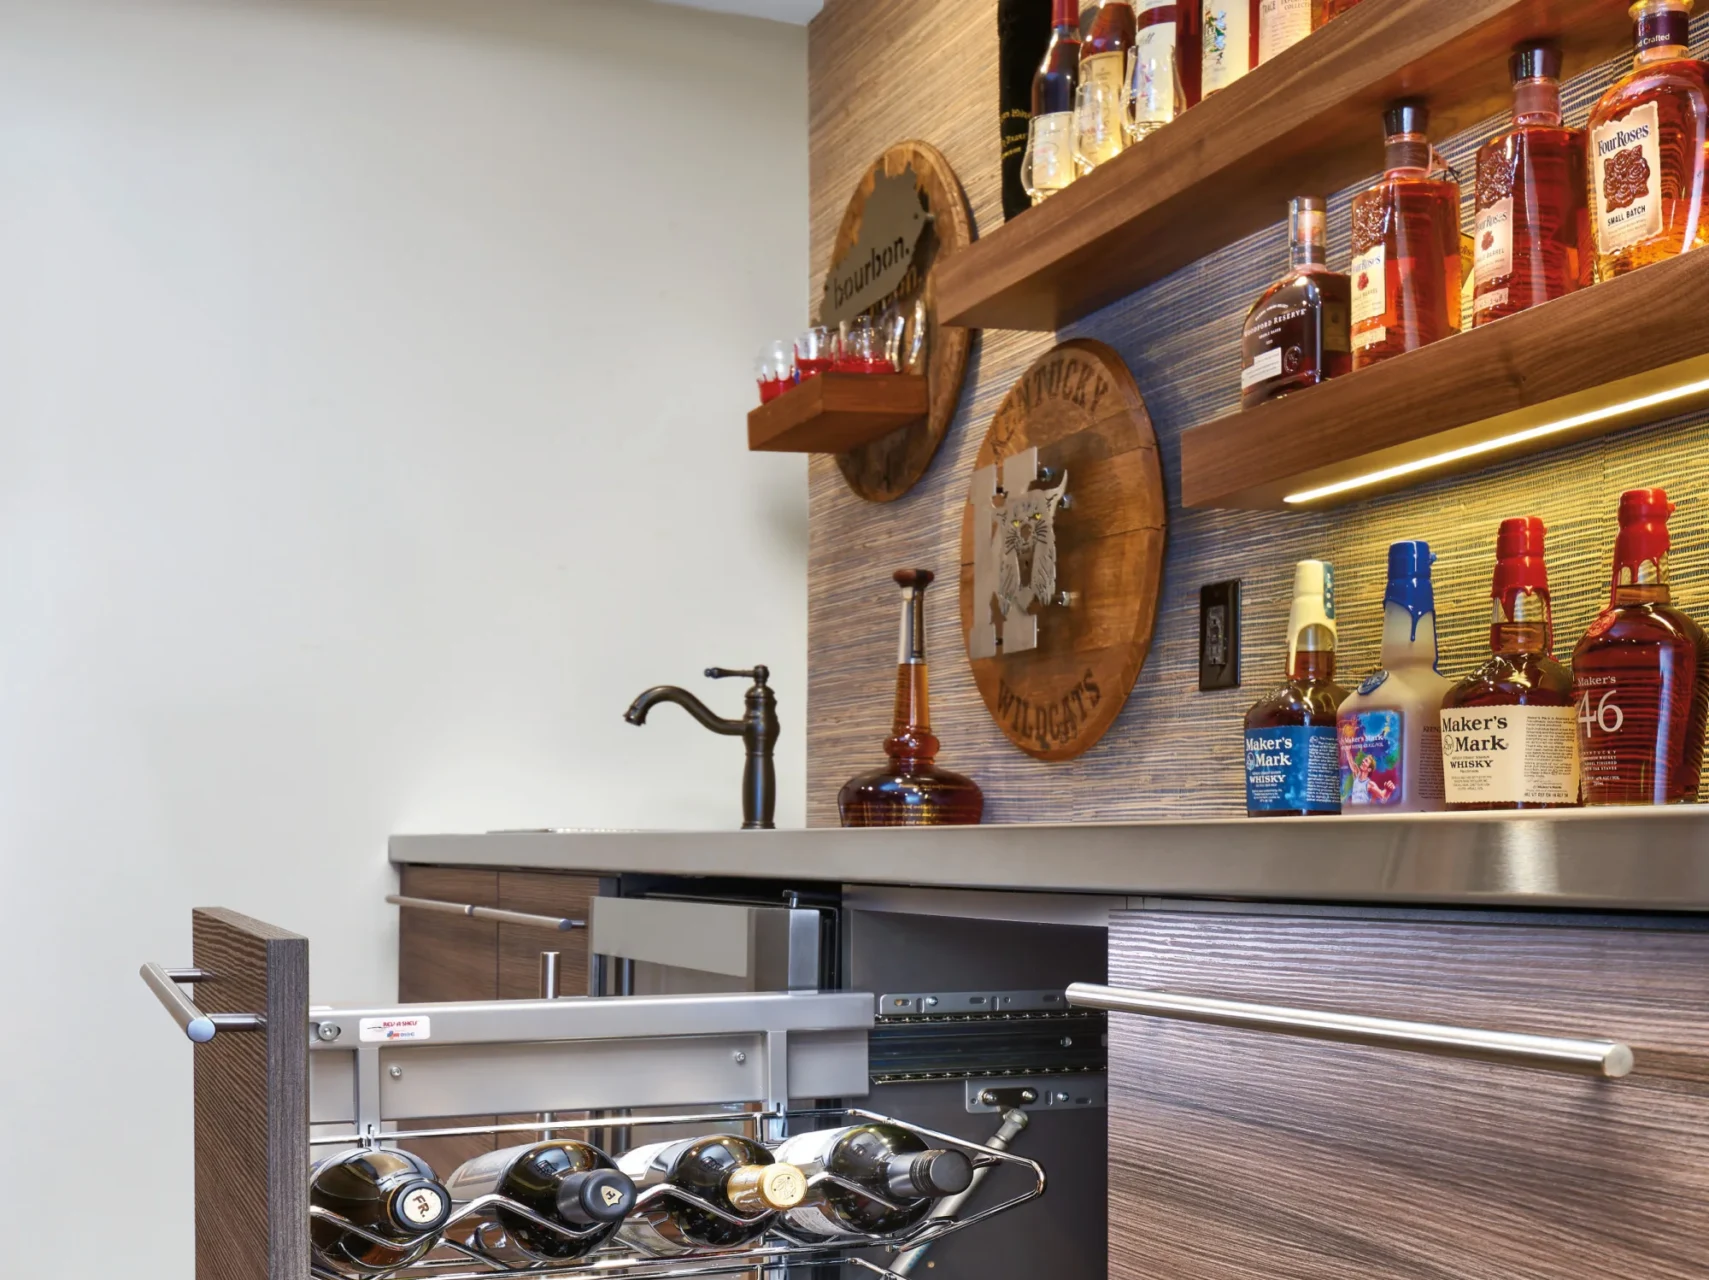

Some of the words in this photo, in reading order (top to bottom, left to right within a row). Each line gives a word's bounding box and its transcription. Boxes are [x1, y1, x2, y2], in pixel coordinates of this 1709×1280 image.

[1643, 33, 1670, 45] Crafted
[1598, 136, 1618, 156] Four
[1616, 124, 1649, 148] Roses
[1607, 212, 1625, 227] SMALL
[1626, 204, 1646, 220] BATCH
[834, 236, 910, 310] bourbon.
[1273, 308, 1307, 325] RESERVE
[1578, 676, 1616, 687] Maker's
[998, 667, 1101, 744] WILDCATS
[1578, 689, 1624, 738] 46
[1442, 716, 1508, 733] Maker's
[1245, 737, 1293, 752] Maker's
[1455, 735, 1508, 753] Mark
[1255, 752, 1292, 767] Mark
[1450, 760, 1494, 769] WHISKY
[1249, 774, 1286, 784] WHISKY
[605, 1190, 615, 1200] H
[412, 1195, 429, 1218] FR.
